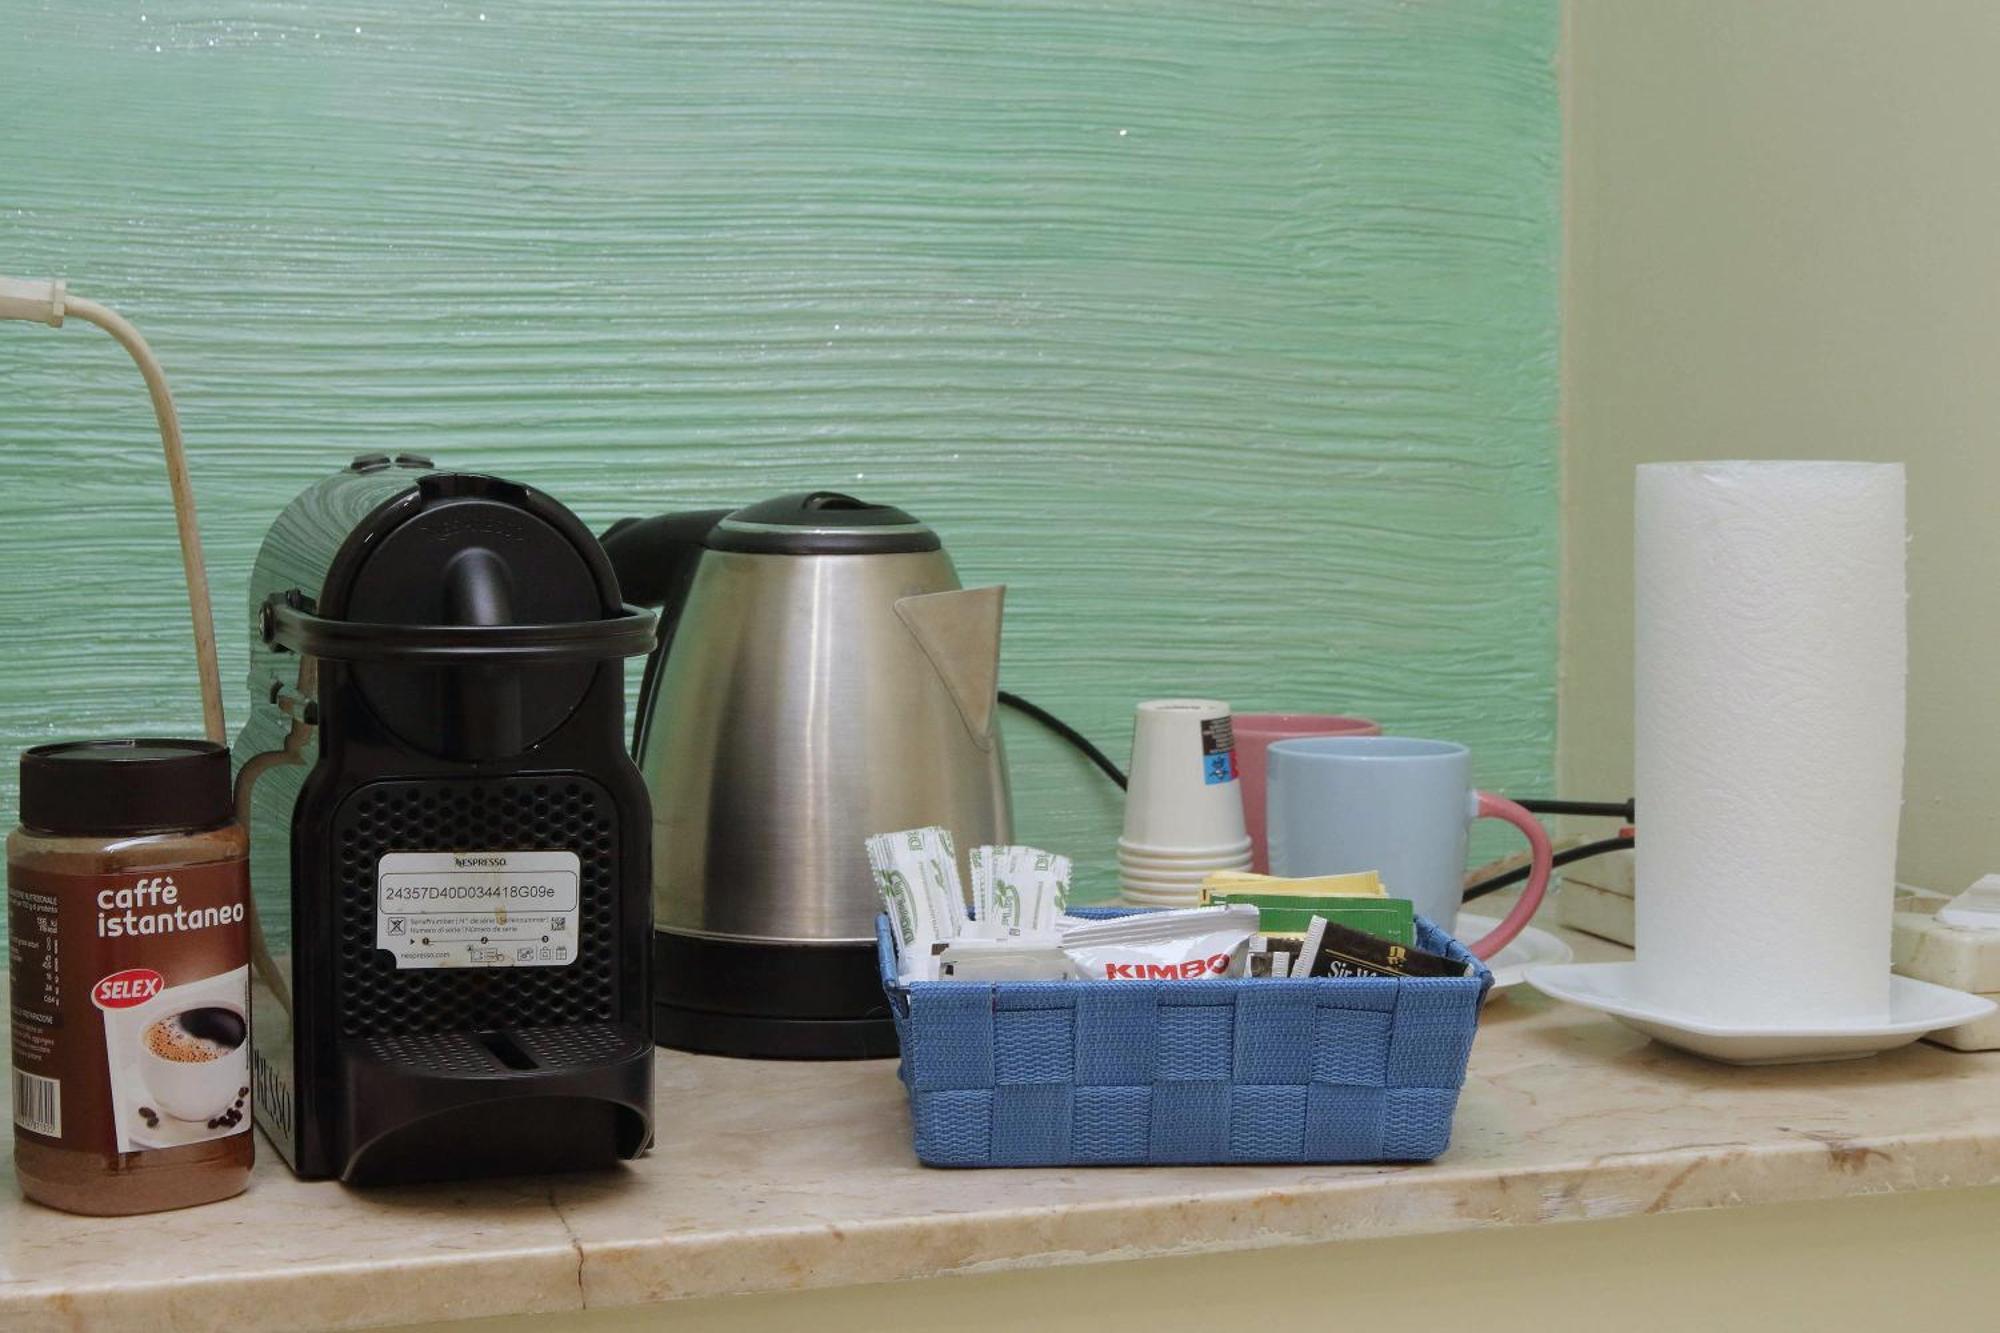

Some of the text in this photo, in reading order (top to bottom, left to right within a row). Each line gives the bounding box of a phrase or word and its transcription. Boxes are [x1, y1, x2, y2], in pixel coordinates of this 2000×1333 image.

[97, 876, 179, 910] caffè
[98, 903, 245, 938] istantaneo
[1105, 953, 1230, 980] KIMBO
[1328, 960, 1353, 978] Sir
[99, 977, 159, 1001] SELEX
